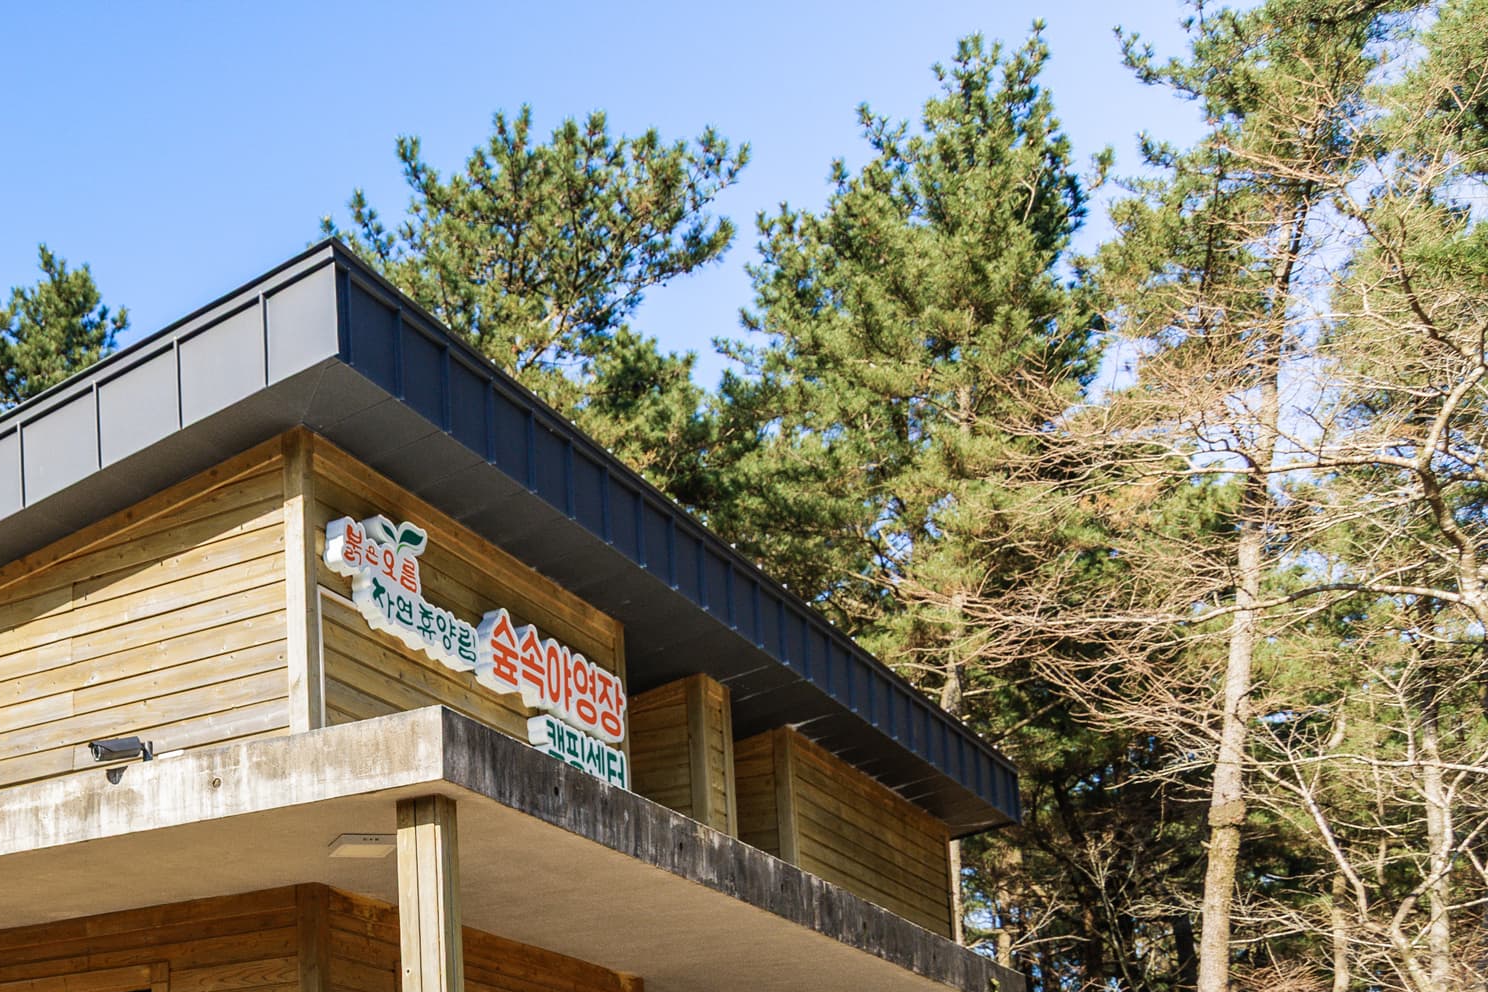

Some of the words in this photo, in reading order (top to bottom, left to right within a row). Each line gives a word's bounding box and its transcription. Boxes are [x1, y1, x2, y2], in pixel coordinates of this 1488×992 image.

[343, 524, 417, 593] 붉은오름
[372, 577, 476, 662] 자연휴양림
[491, 615, 624, 737] 숲속야영장
